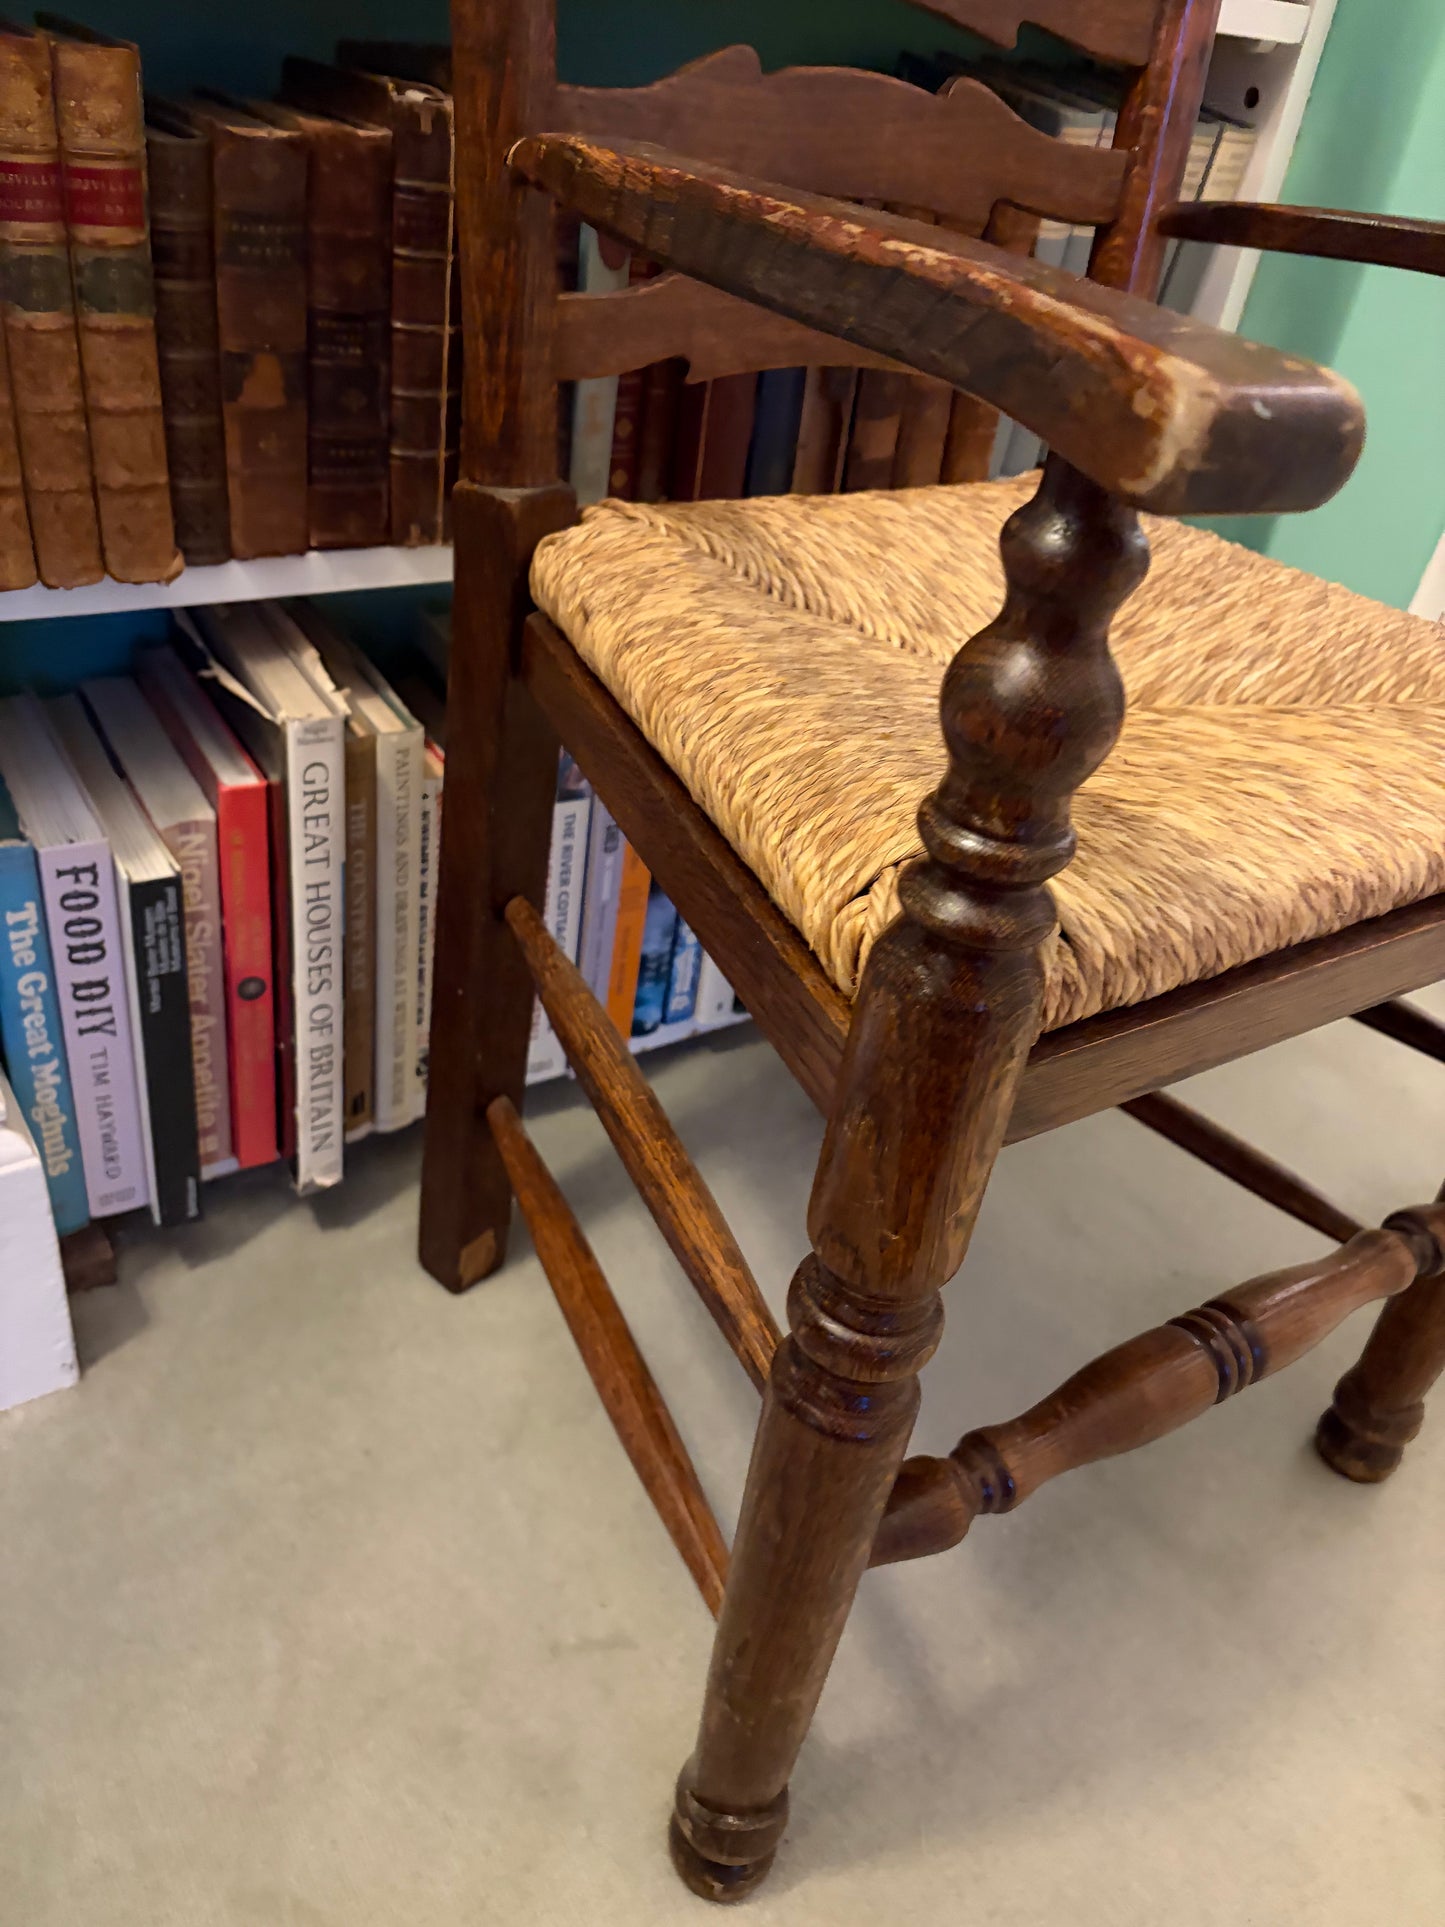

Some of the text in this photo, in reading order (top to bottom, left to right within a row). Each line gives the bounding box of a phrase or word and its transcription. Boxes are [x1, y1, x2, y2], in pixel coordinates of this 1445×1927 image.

[302, 762, 331, 869] GREAT
[395, 748, 411, 845] PAINTINGS
[560, 811, 577, 842] THE
[176, 833, 211, 912] Nigel
[394, 851, 410, 885] AND
[558, 844, 575, 889] RIVER
[55, 861, 118, 1037] FOOD DIY
[184, 920, 215, 1005] Slater
[305, 881, 333, 996] HOUSES
[5, 901, 74, 1178] The Great Moghuls
[308, 1004, 334, 1036] OF
[90, 1046, 111, 1087] TIM
[309, 1045, 335, 1153] BRITAIN
[94, 1093, 124, 1181] HAYWARD
